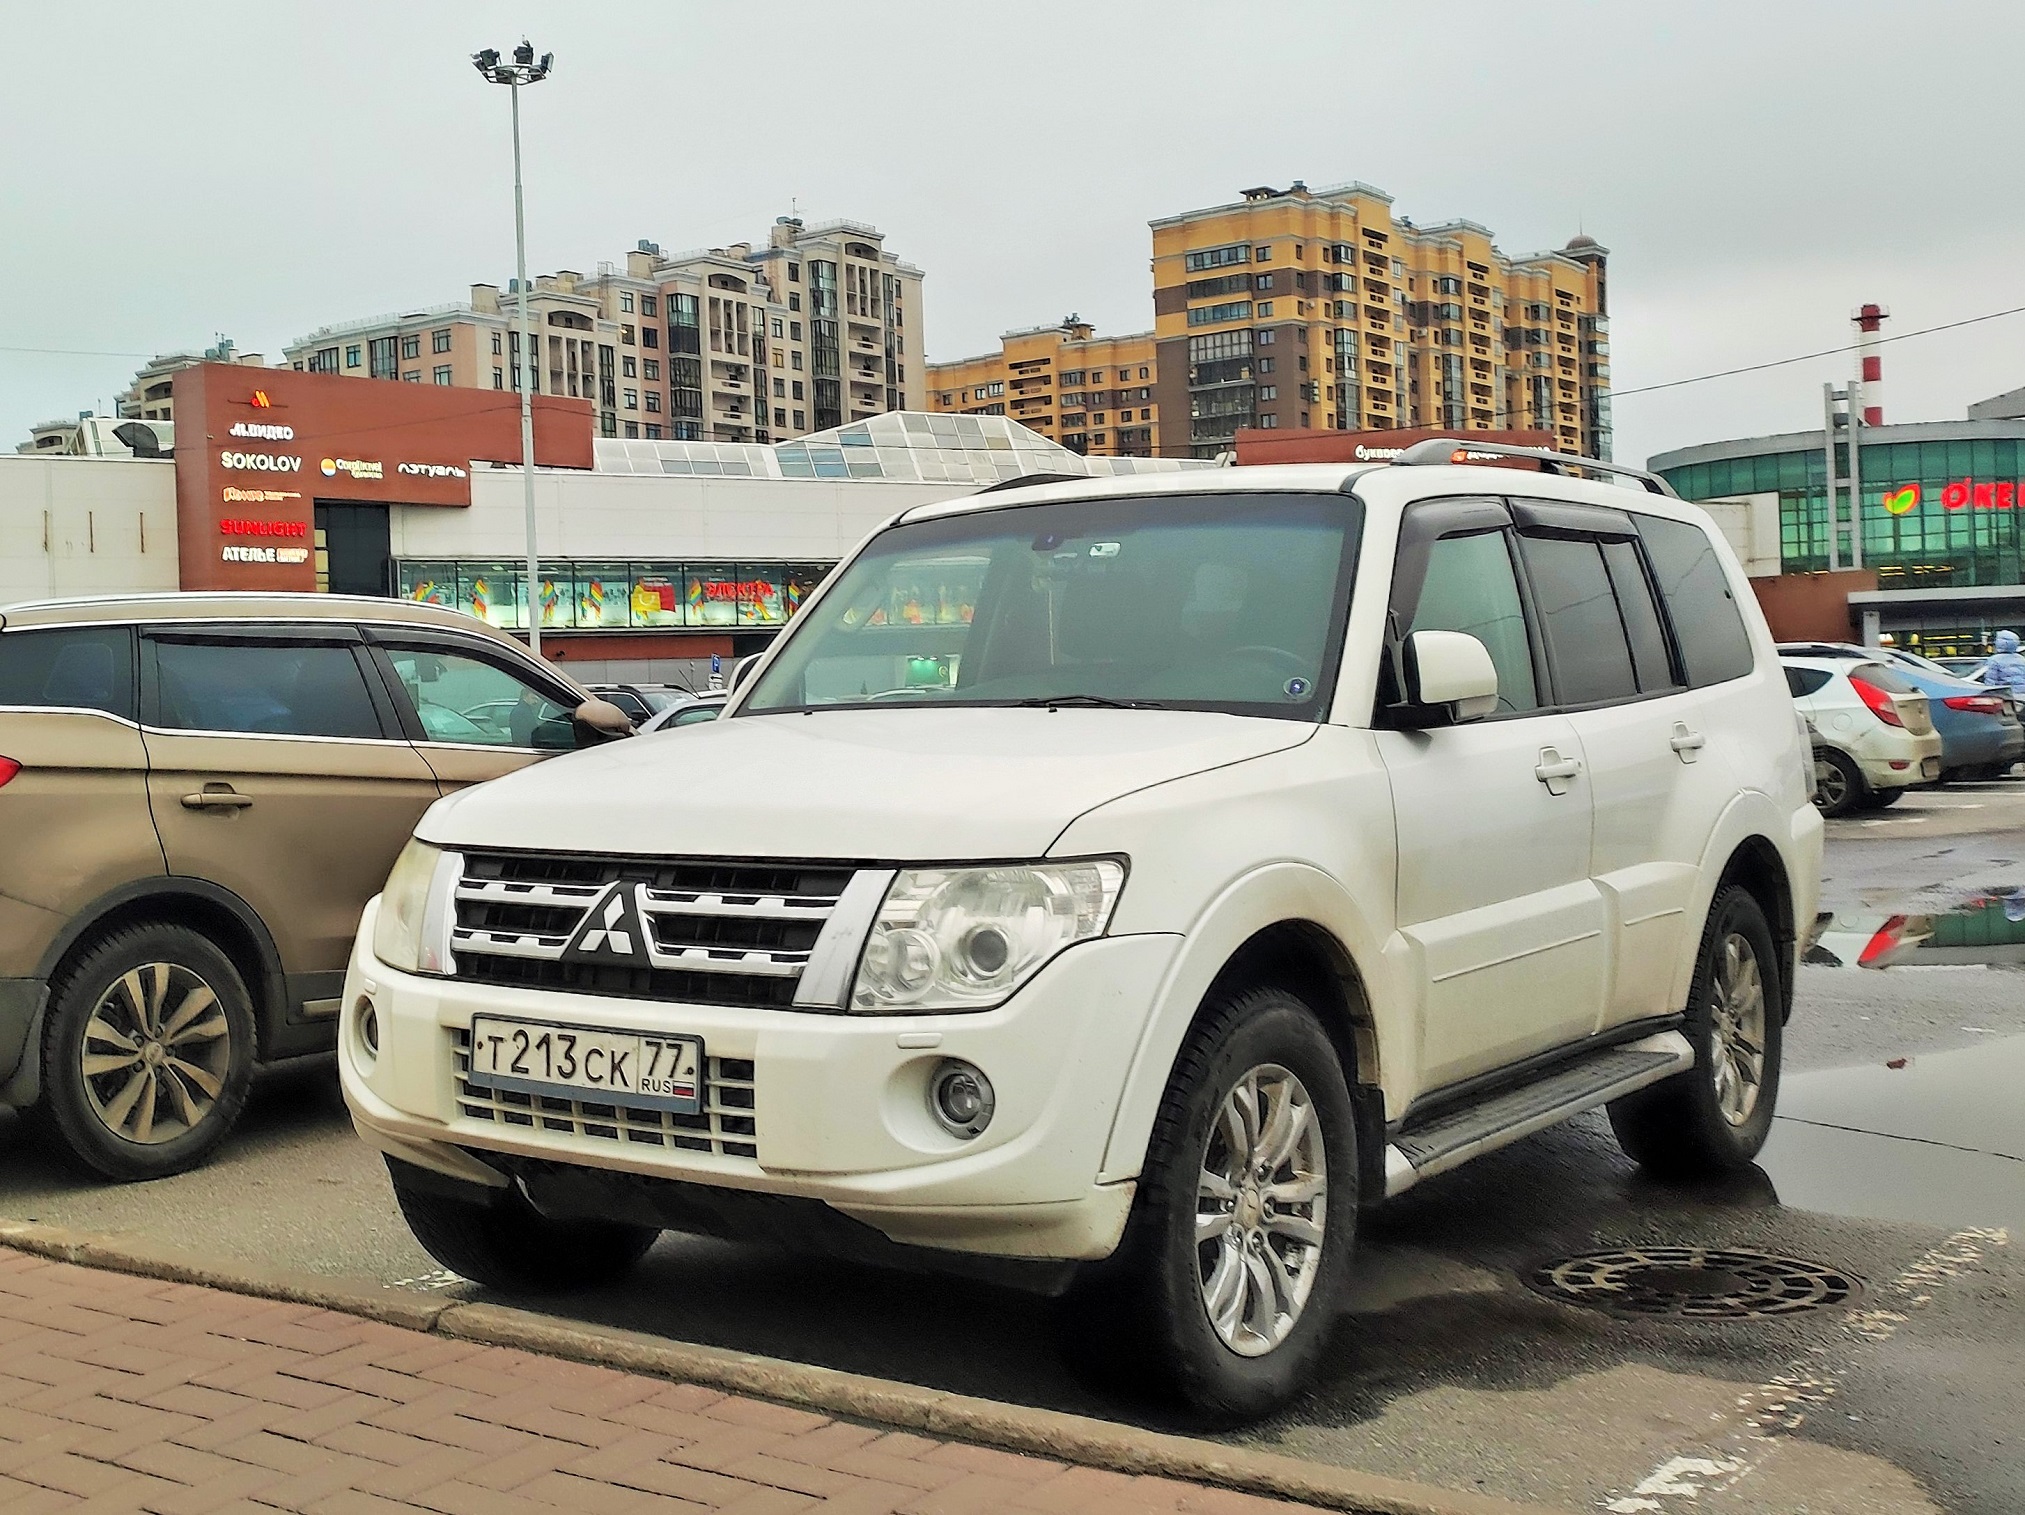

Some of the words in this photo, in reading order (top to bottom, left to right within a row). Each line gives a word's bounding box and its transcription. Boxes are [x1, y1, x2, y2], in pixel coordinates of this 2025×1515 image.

[221, 451, 302, 472] SOKOLOV
[220, 519, 307, 537] SUNLIGHT
[222, 546, 276, 562] АТЕЛЬЕ
[645, 1040, 683, 1078] 77
[641, 1078, 672, 1094] RUS
